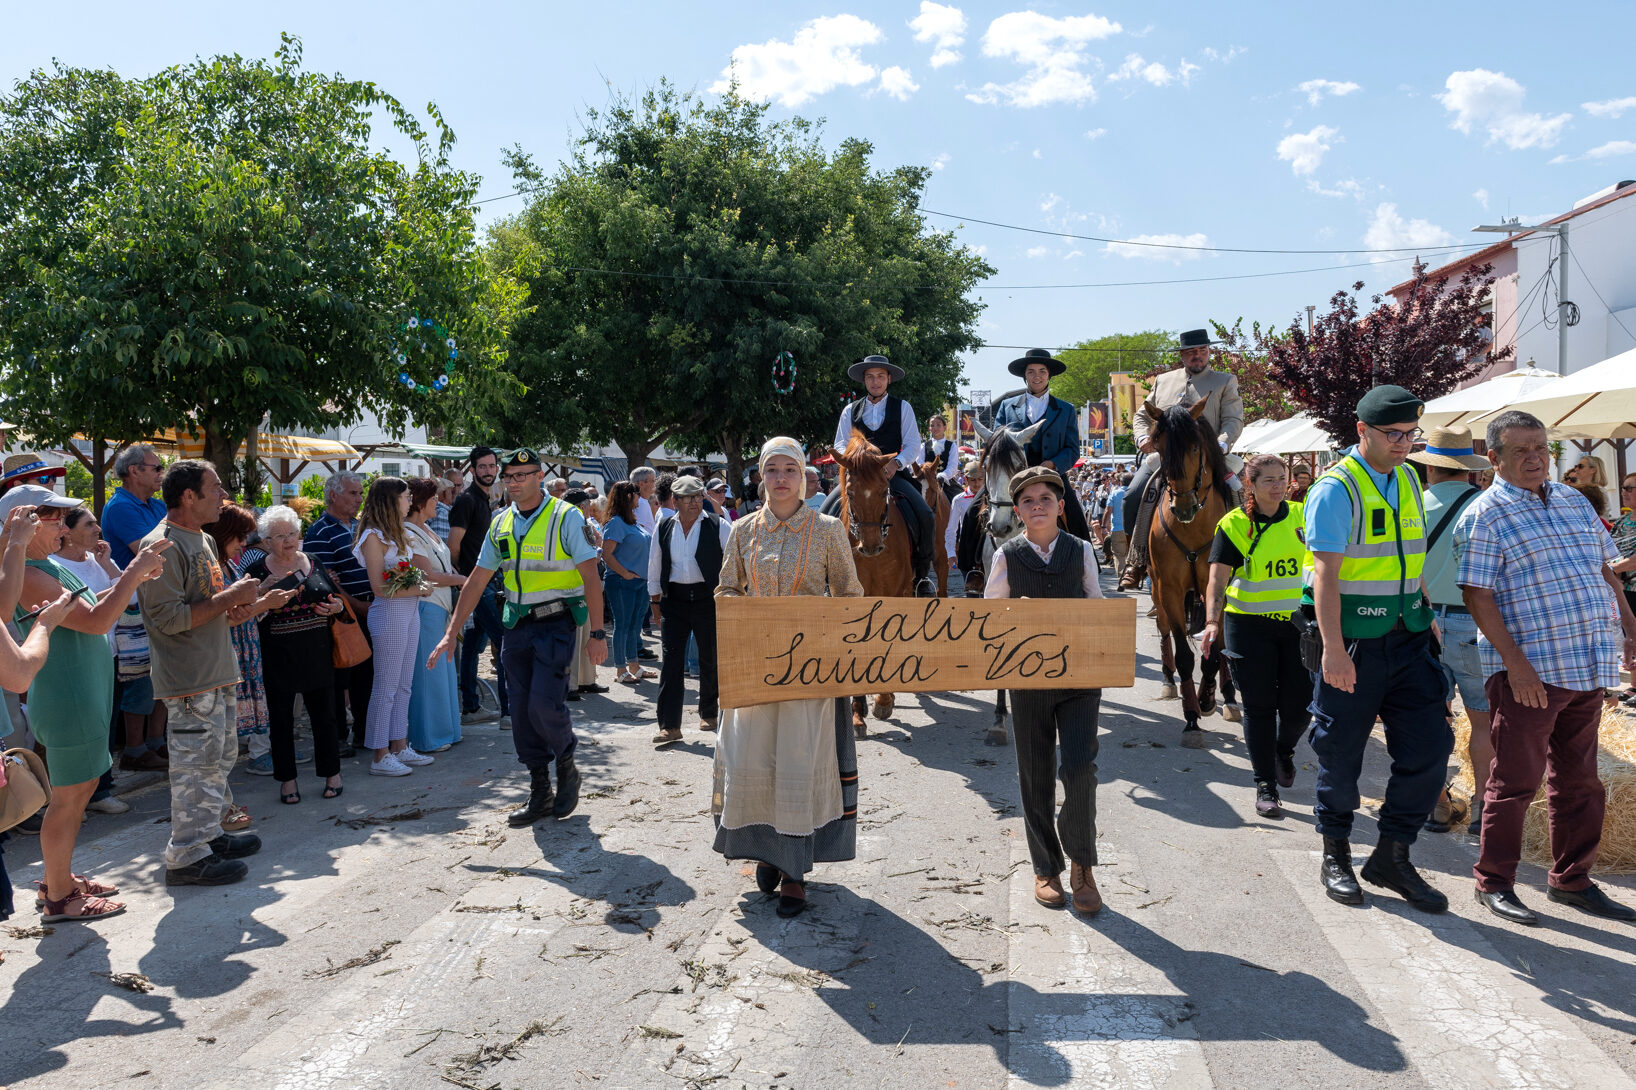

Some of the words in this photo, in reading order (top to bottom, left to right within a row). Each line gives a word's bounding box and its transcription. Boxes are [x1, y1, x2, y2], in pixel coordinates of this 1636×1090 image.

[1401, 518, 1422, 528] GNR
[522, 544, 544, 554] GNR
[1265, 557, 1299, 578] 163
[1357, 606, 1388, 617] GNR
[841, 598, 1017, 644] Salir
[983, 633, 1070, 681] Vos
